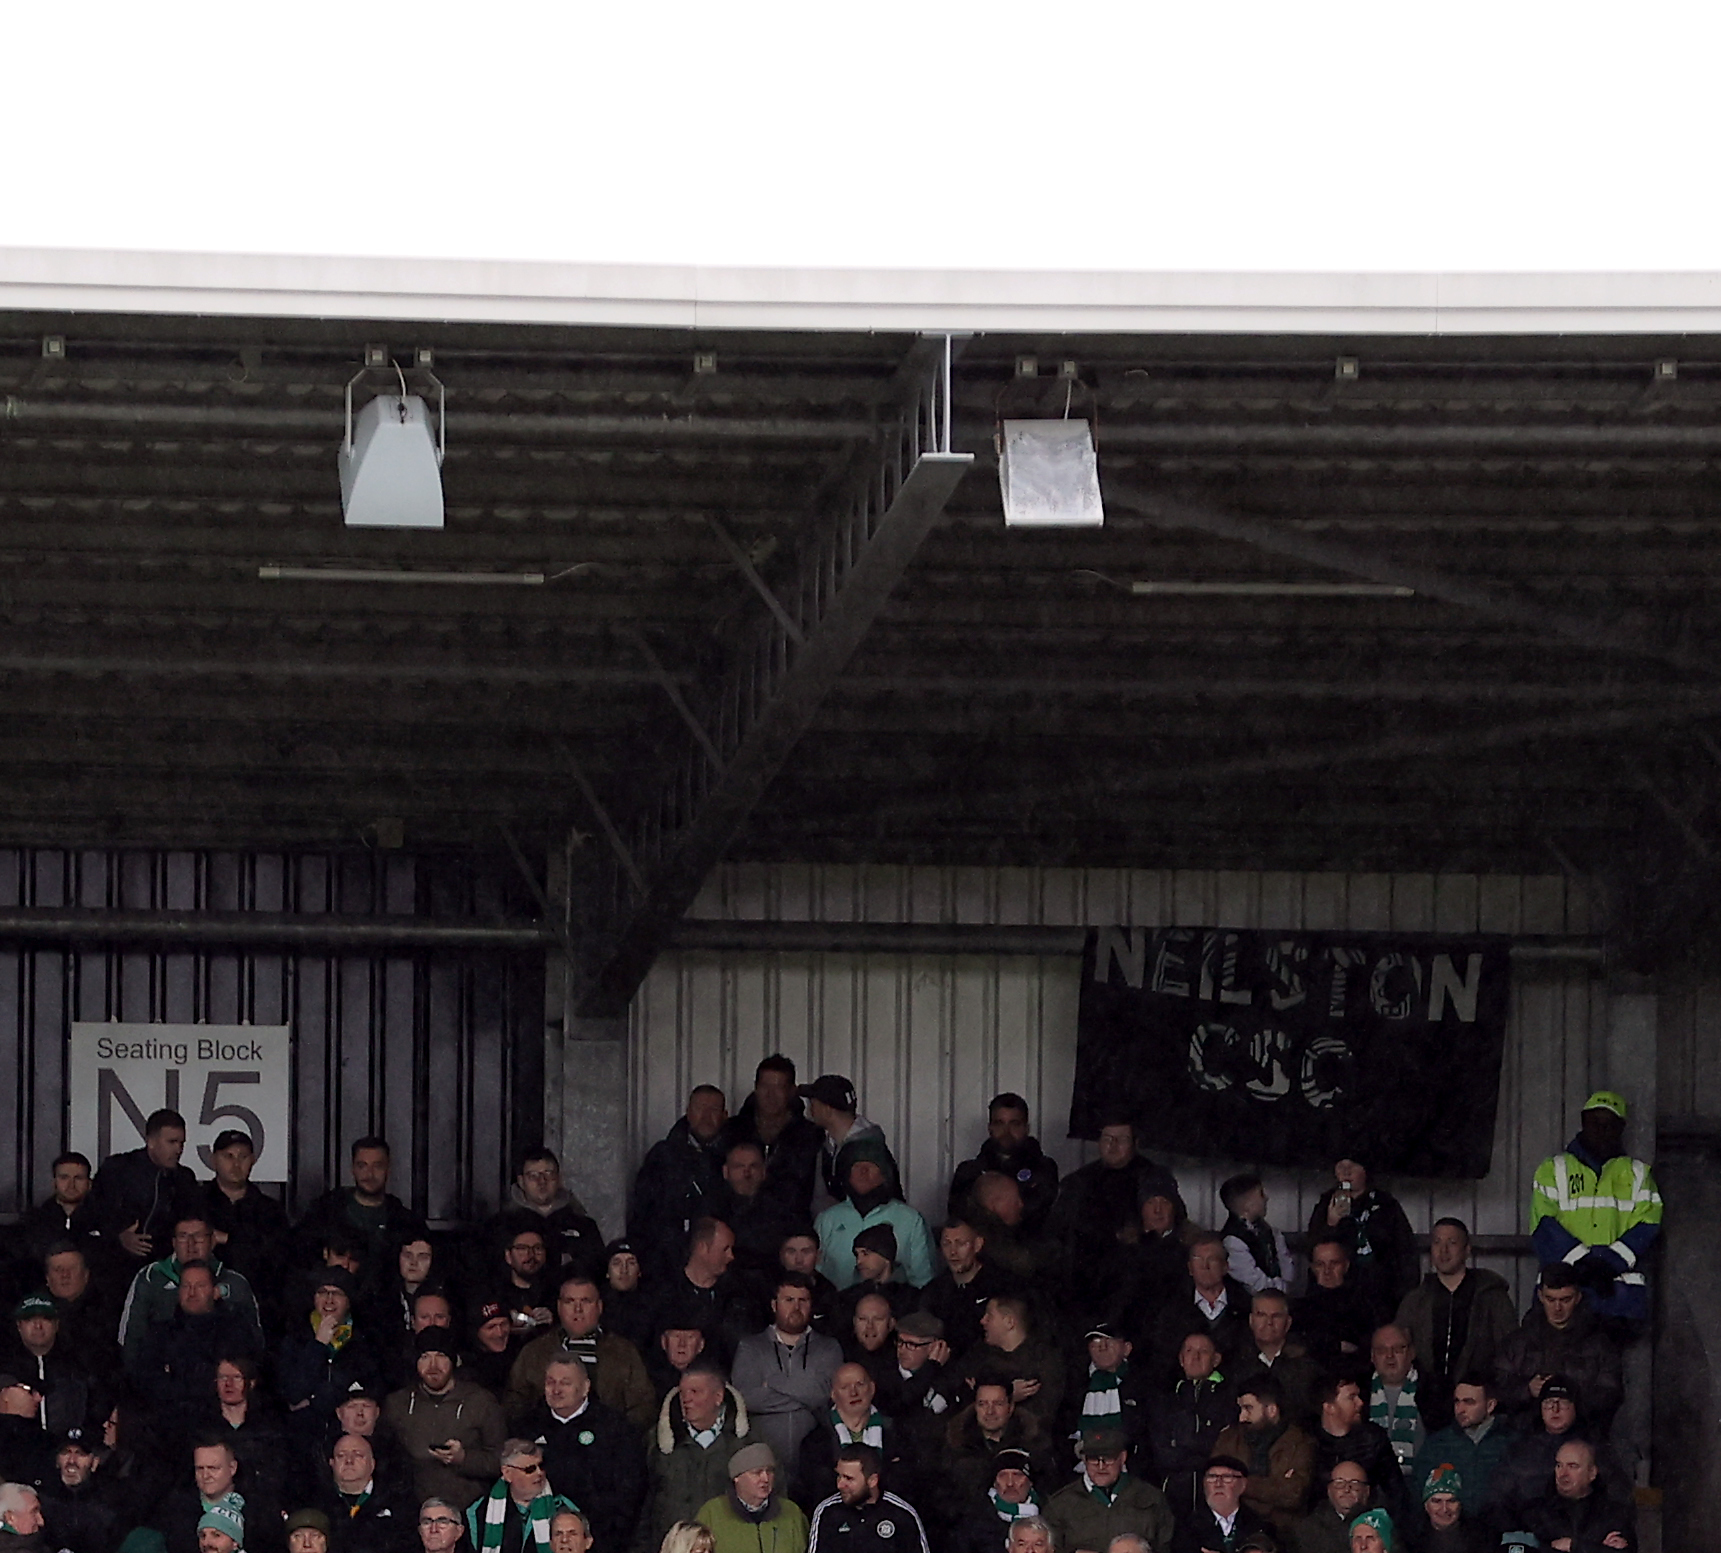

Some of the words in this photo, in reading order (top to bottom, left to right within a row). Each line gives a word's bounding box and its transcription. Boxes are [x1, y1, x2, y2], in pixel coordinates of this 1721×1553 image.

[1094, 926, 1482, 1022] NEILSTON
[97, 1037, 187, 1064] Seating
[198, 1038, 263, 1060] Block
[1188, 1022, 1353, 1107] CSC
[98, 1068, 265, 1173] N5
